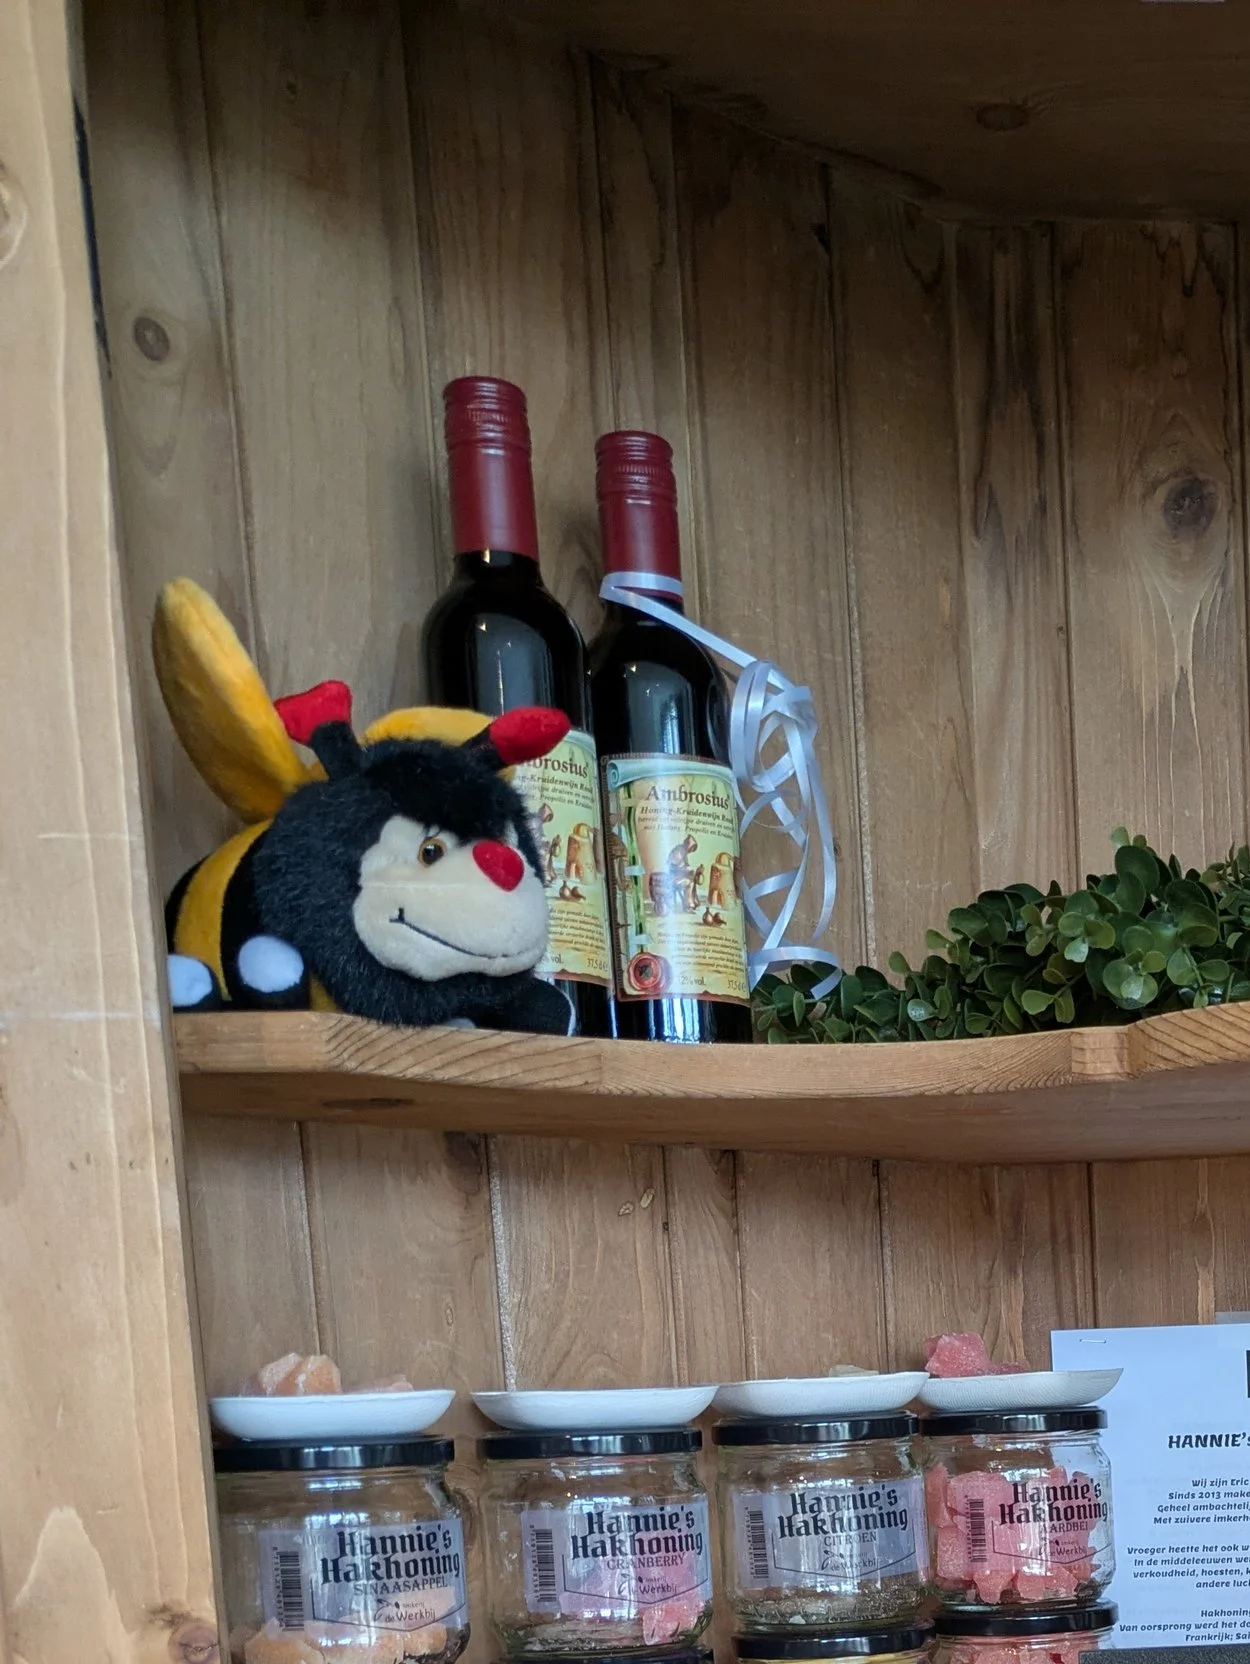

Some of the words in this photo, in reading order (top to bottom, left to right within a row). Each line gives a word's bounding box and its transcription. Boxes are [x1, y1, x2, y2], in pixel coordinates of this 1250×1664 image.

[646, 783, 730, 811] Ambrosius
[1012, 1477, 1102, 1503] Hannie's
[1191, 1477, 1207, 1489] Wij
[1209, 1477, 1228, 1488] zijn
[1229, 1476, 1249, 1486] Eric
[1167, 1490, 1196, 1500] Sinds
[1197, 1490, 1221, 1500] 2013
[999, 1497, 1108, 1526] Hakhoning
[1156, 1502, 1191, 1513] Geheel
[585, 1504, 695, 1536] Hannie's
[1153, 1515, 1172, 1525] Met
[1173, 1514, 1211, 1524] zuivere
[337, 1524, 452, 1558] Hannie's
[571, 1528, 704, 1560] Hakhoning
[1126, 1546, 1166, 1556] Vroeger
[1167, 1544, 1200, 1554] heette
[1201, 1543, 1219, 1553] het
[1219, 1542, 1239, 1552] ook
[320, 1548, 461, 1586] Hakhoning
[606, 1553, 686, 1570] CRANBERRY
[1133, 1557, 1144, 1567] In
[1145, 1557, 1159, 1566] de
[1160, 1555, 1233, 1566] middeleeuwen
[1132, 1567, 1199, 1578] verkoudheid,
[1200, 1567, 1243, 1576] hoesten,
[353, 1576, 449, 1596] SINAASAPPEL
[1195, 1579, 1231, 1588] andere
